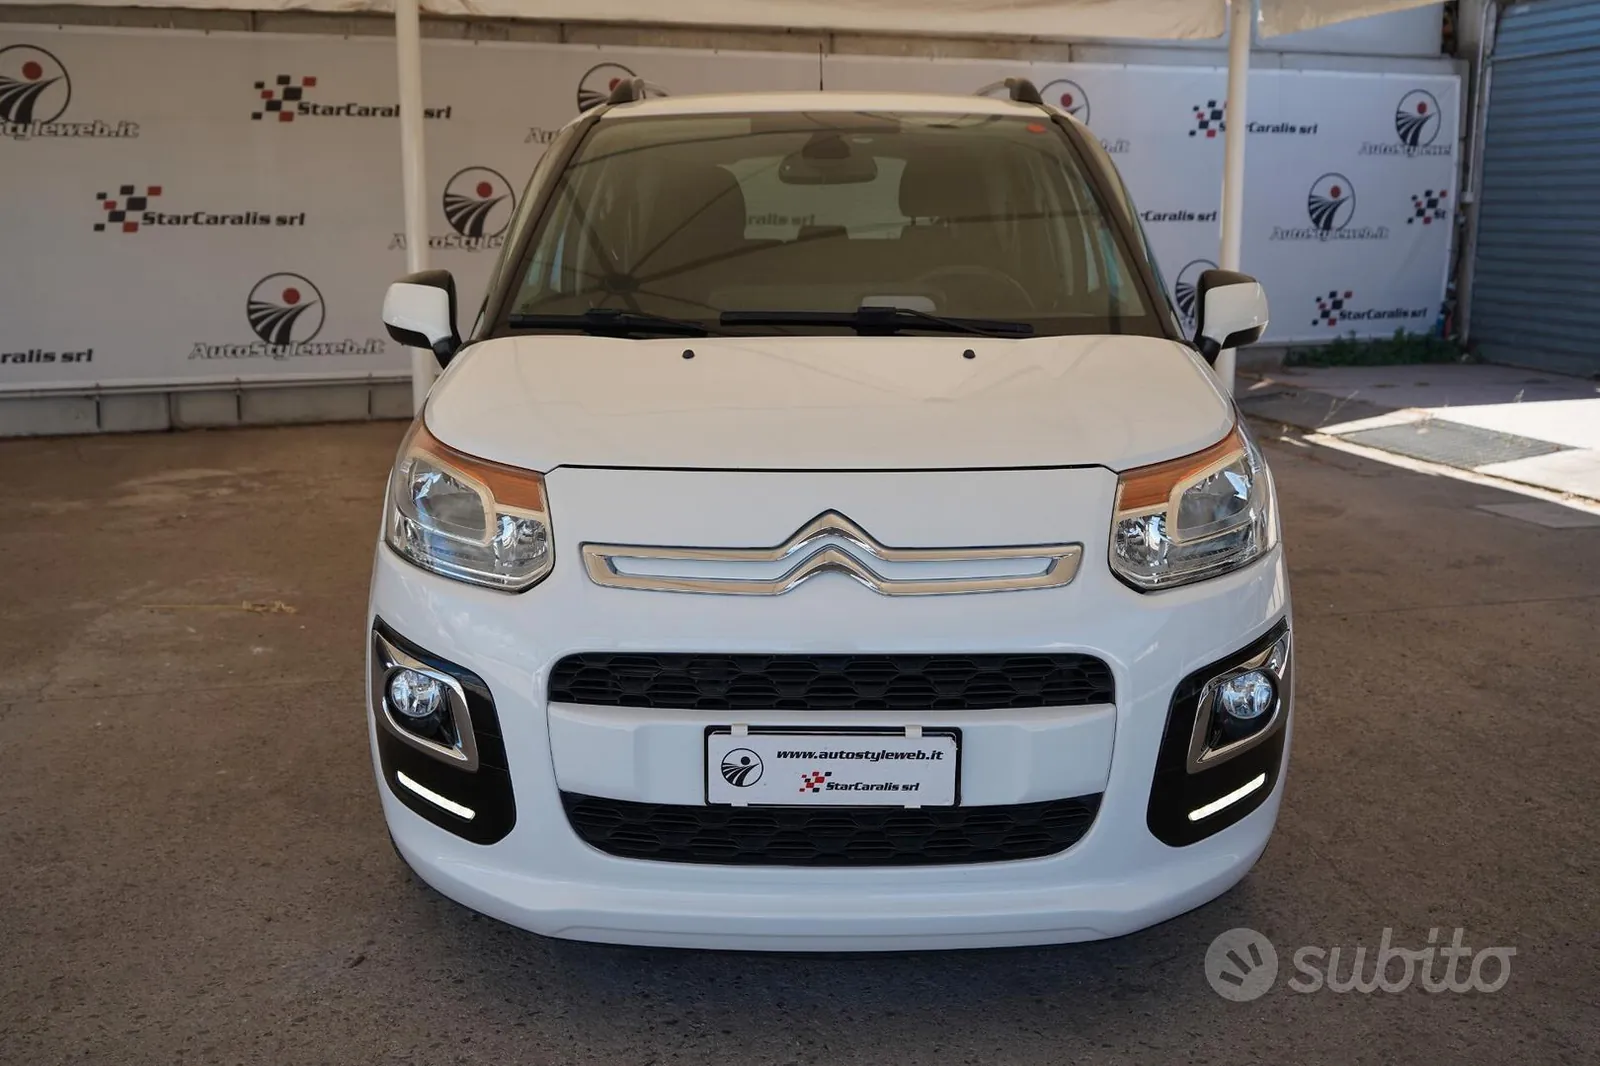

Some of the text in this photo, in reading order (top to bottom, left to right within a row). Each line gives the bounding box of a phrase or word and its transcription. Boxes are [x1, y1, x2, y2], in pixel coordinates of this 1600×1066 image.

[297, 102, 452, 119] StarCaral srl
[0, 119, 139, 140] tyleweb.it
[142, 211, 305, 226] StarCaralis srl
[1198, 211, 1218, 222] srl
[1340, 307, 1428, 320] StarCaralis srl
[61, 348, 93, 363] srl
[188, 338, 386, 361] AutoStyleweb.it
[776, 750, 944, 762] www.autostyleweb.it
[825, 782, 920, 792] StarCaralis srl
